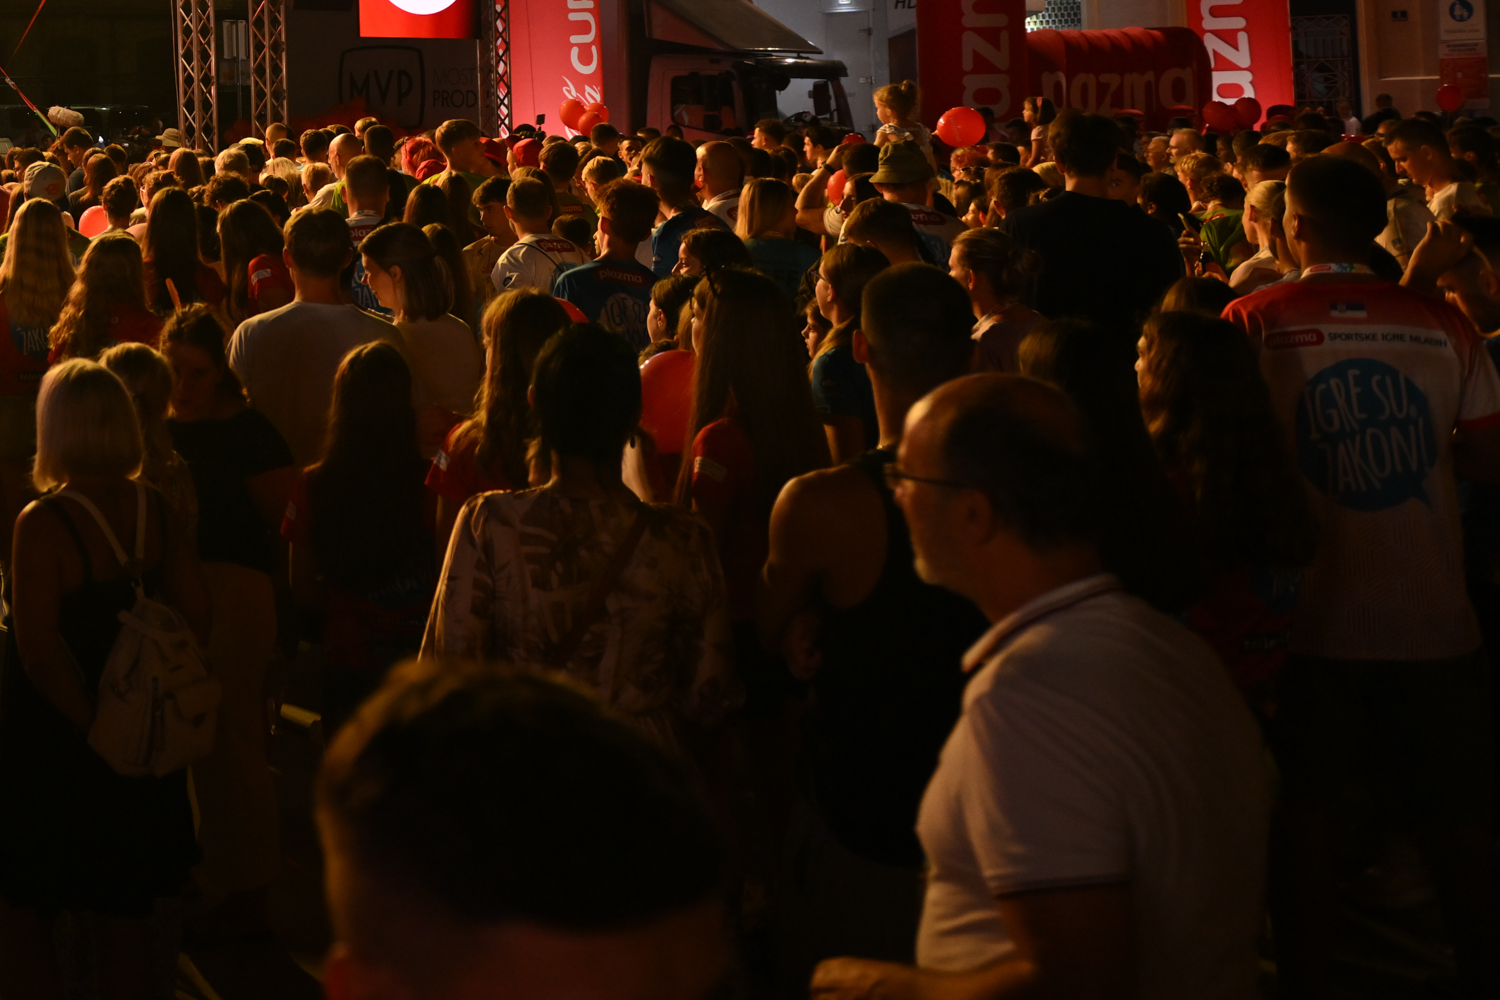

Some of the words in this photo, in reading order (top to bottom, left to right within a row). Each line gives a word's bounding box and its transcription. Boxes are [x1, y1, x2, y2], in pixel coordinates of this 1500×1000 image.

[599, 268, 644, 283] plazma
[1269, 331, 1318, 347] plazma
[1328, 332, 1379, 343] SPORTSKE
[1381, 332, 1407, 343] IGRE
[1409, 334, 1448, 348] MLADIH
[1304, 368, 1368, 440] IGRE
